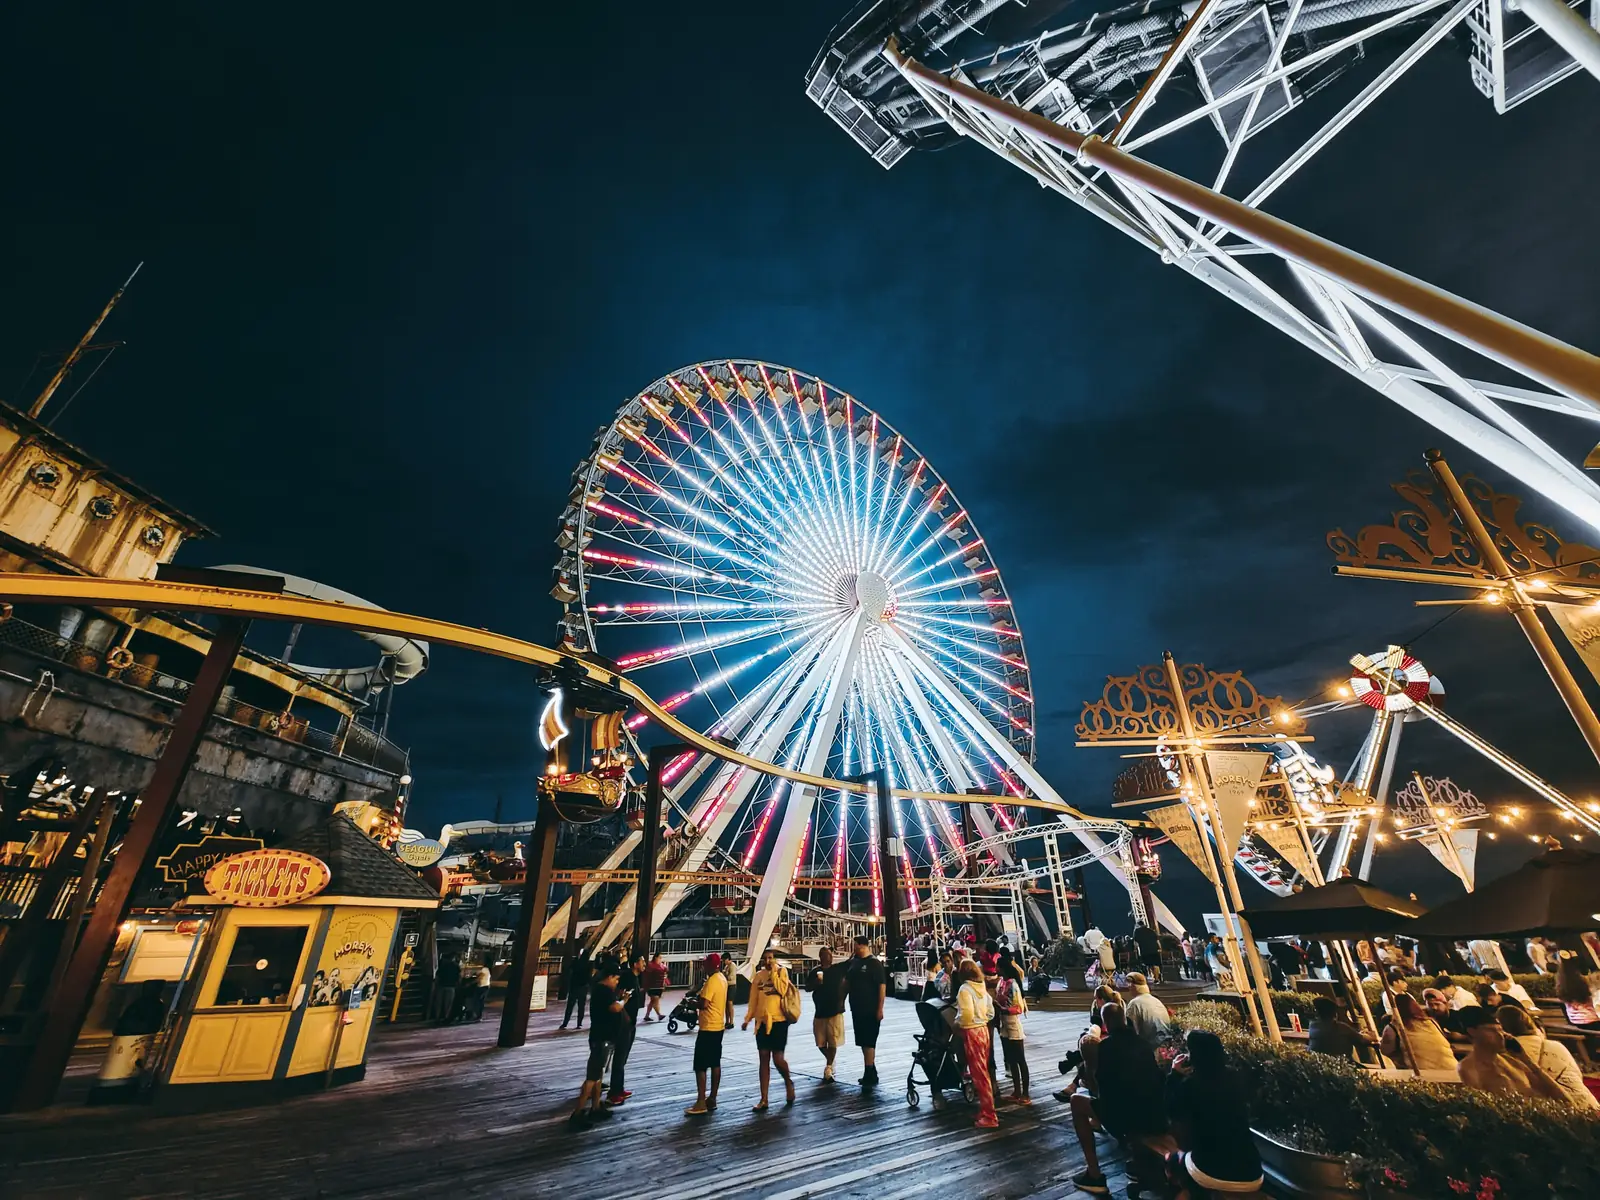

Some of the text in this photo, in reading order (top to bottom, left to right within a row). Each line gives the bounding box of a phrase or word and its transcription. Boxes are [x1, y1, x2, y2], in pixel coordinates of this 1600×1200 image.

[1215, 774, 1256, 788] MOREY'S
[399, 843, 441, 854] SEAGULL
[170, 852, 221, 879] HAPPY
[222, 857, 311, 898] TICKETS
[333, 940, 375, 960] MOREY'S
